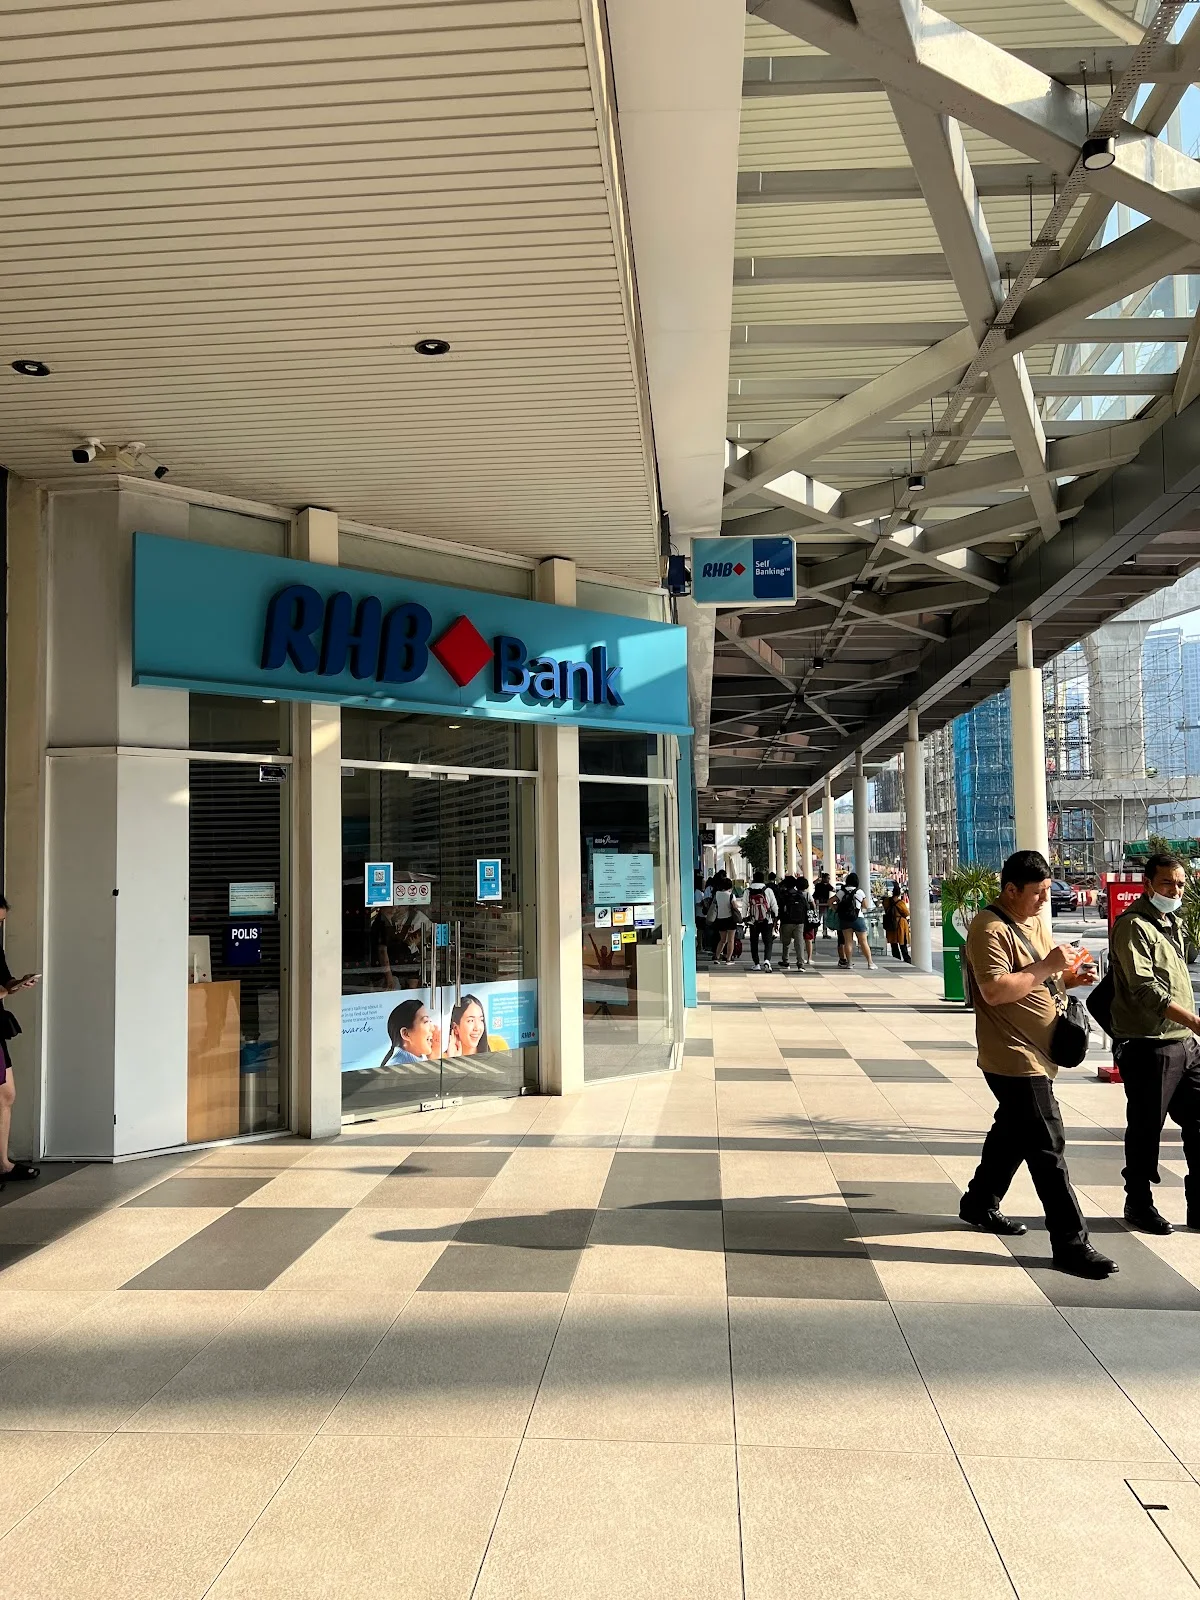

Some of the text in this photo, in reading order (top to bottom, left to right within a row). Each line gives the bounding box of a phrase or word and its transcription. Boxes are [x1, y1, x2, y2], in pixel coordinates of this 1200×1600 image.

[702, 562, 733, 578] RHB
[755, 560, 769, 568] Self
[260, 584, 624, 707] RHB Bank
[231, 928, 258, 940] POLIS
